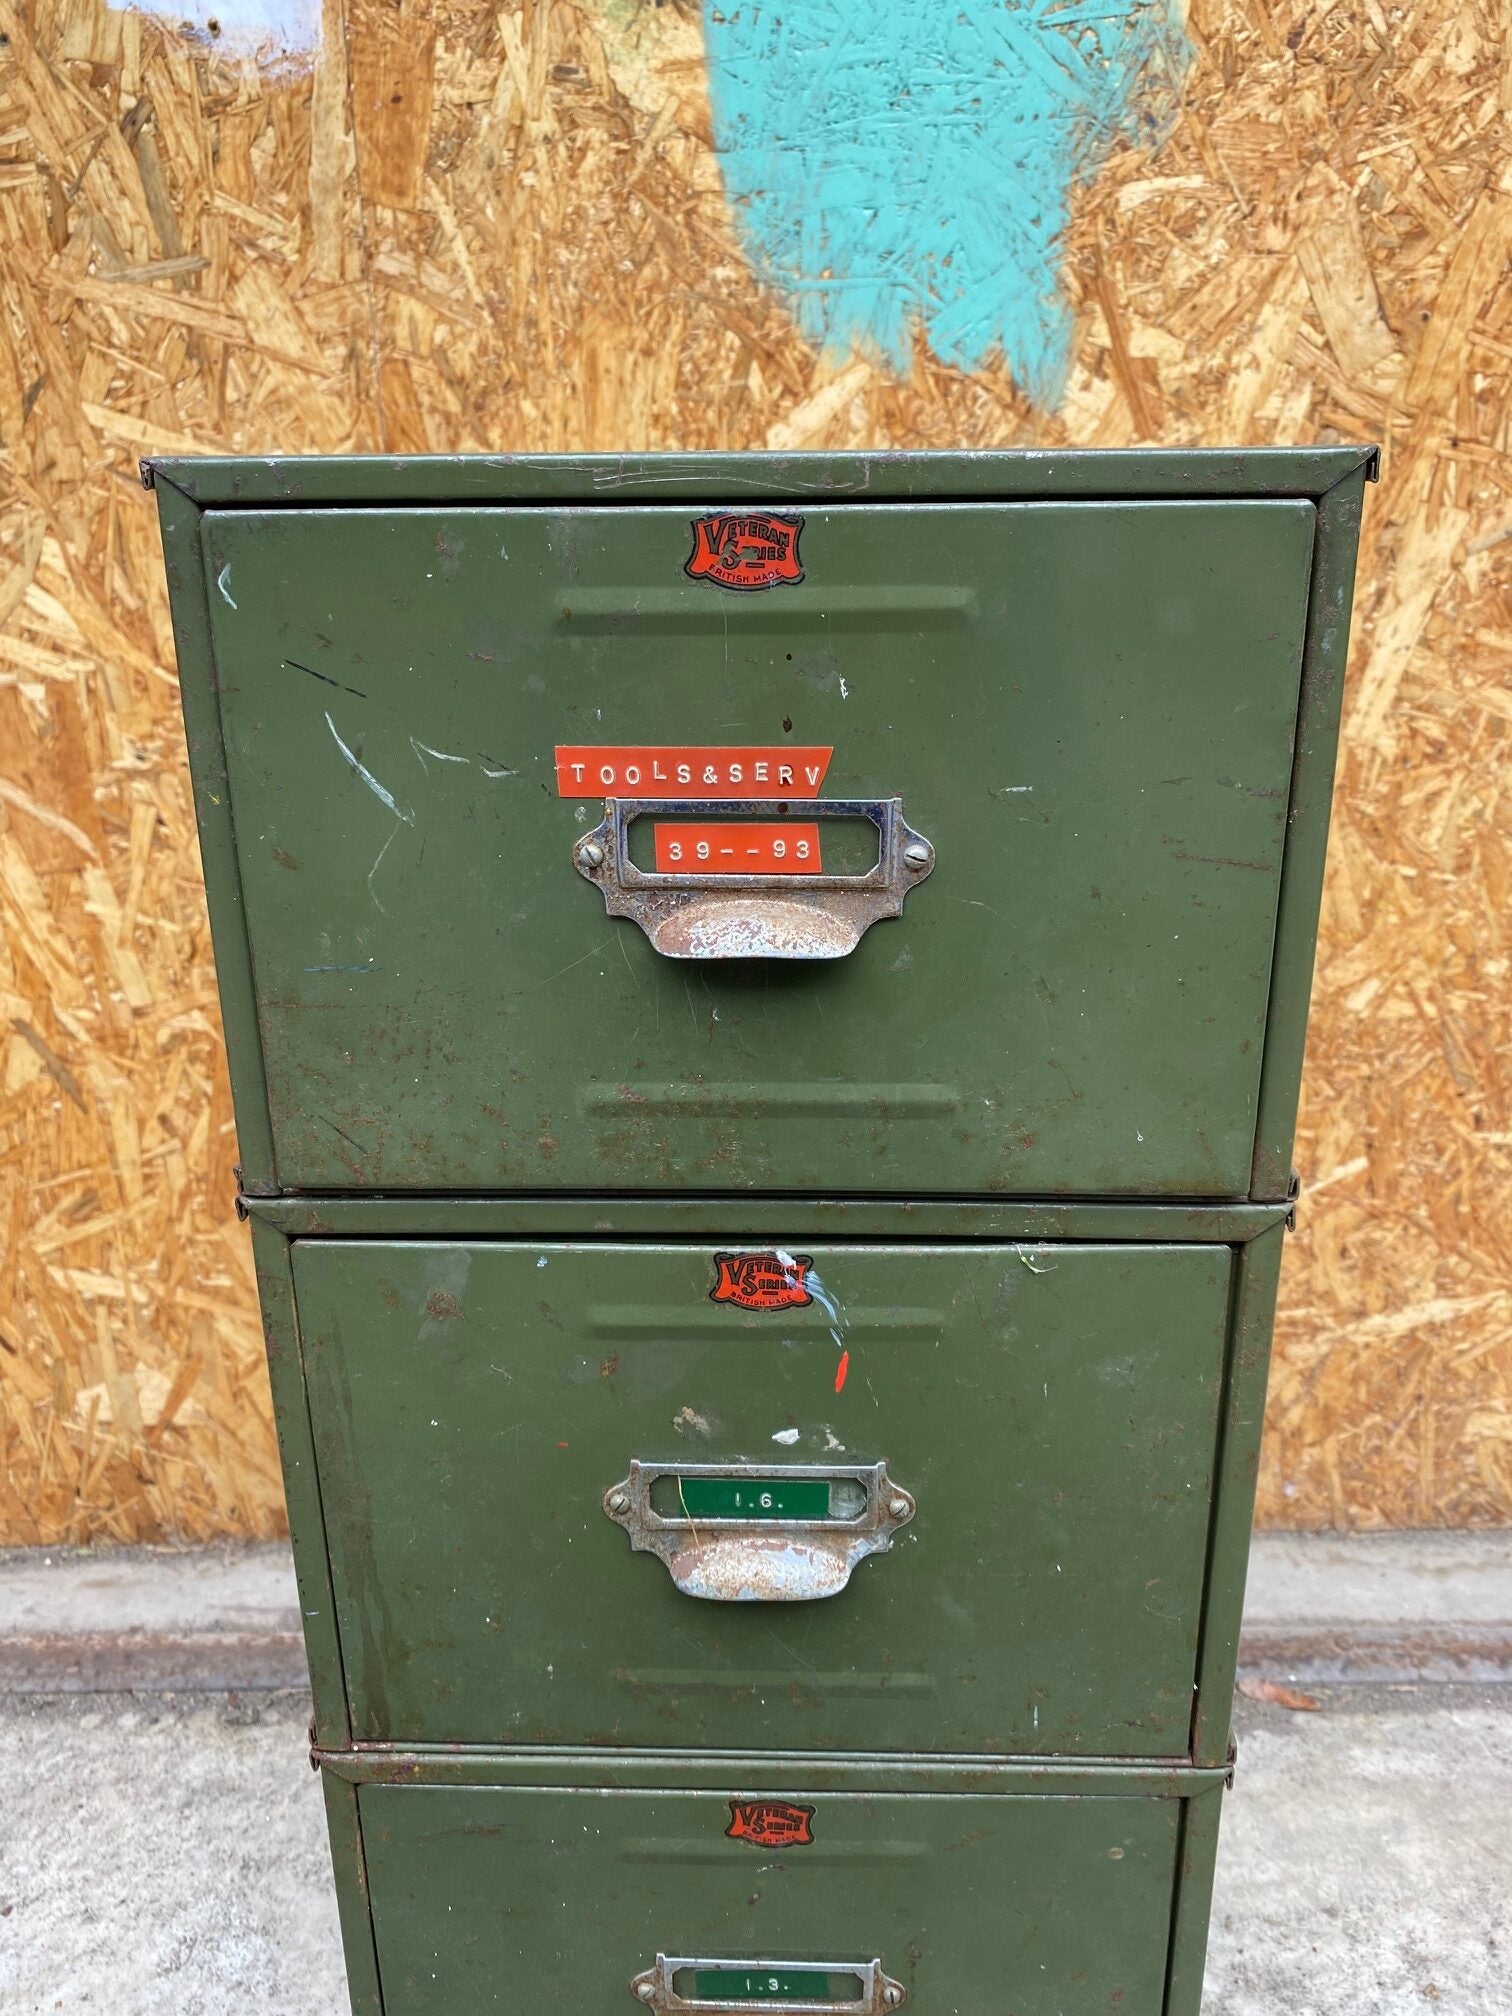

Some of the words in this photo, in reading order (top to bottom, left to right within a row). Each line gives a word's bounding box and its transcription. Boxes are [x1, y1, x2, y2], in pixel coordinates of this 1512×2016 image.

[703, 519, 790, 555] VETERAN
[753, 568, 782, 582] MADE
[570, 760, 820, 786] TOOLS&SERV
[668, 839, 810, 861] 39--93
[730, 1291, 766, 1306] BRITISH
[768, 1294, 793, 1306] MADE
